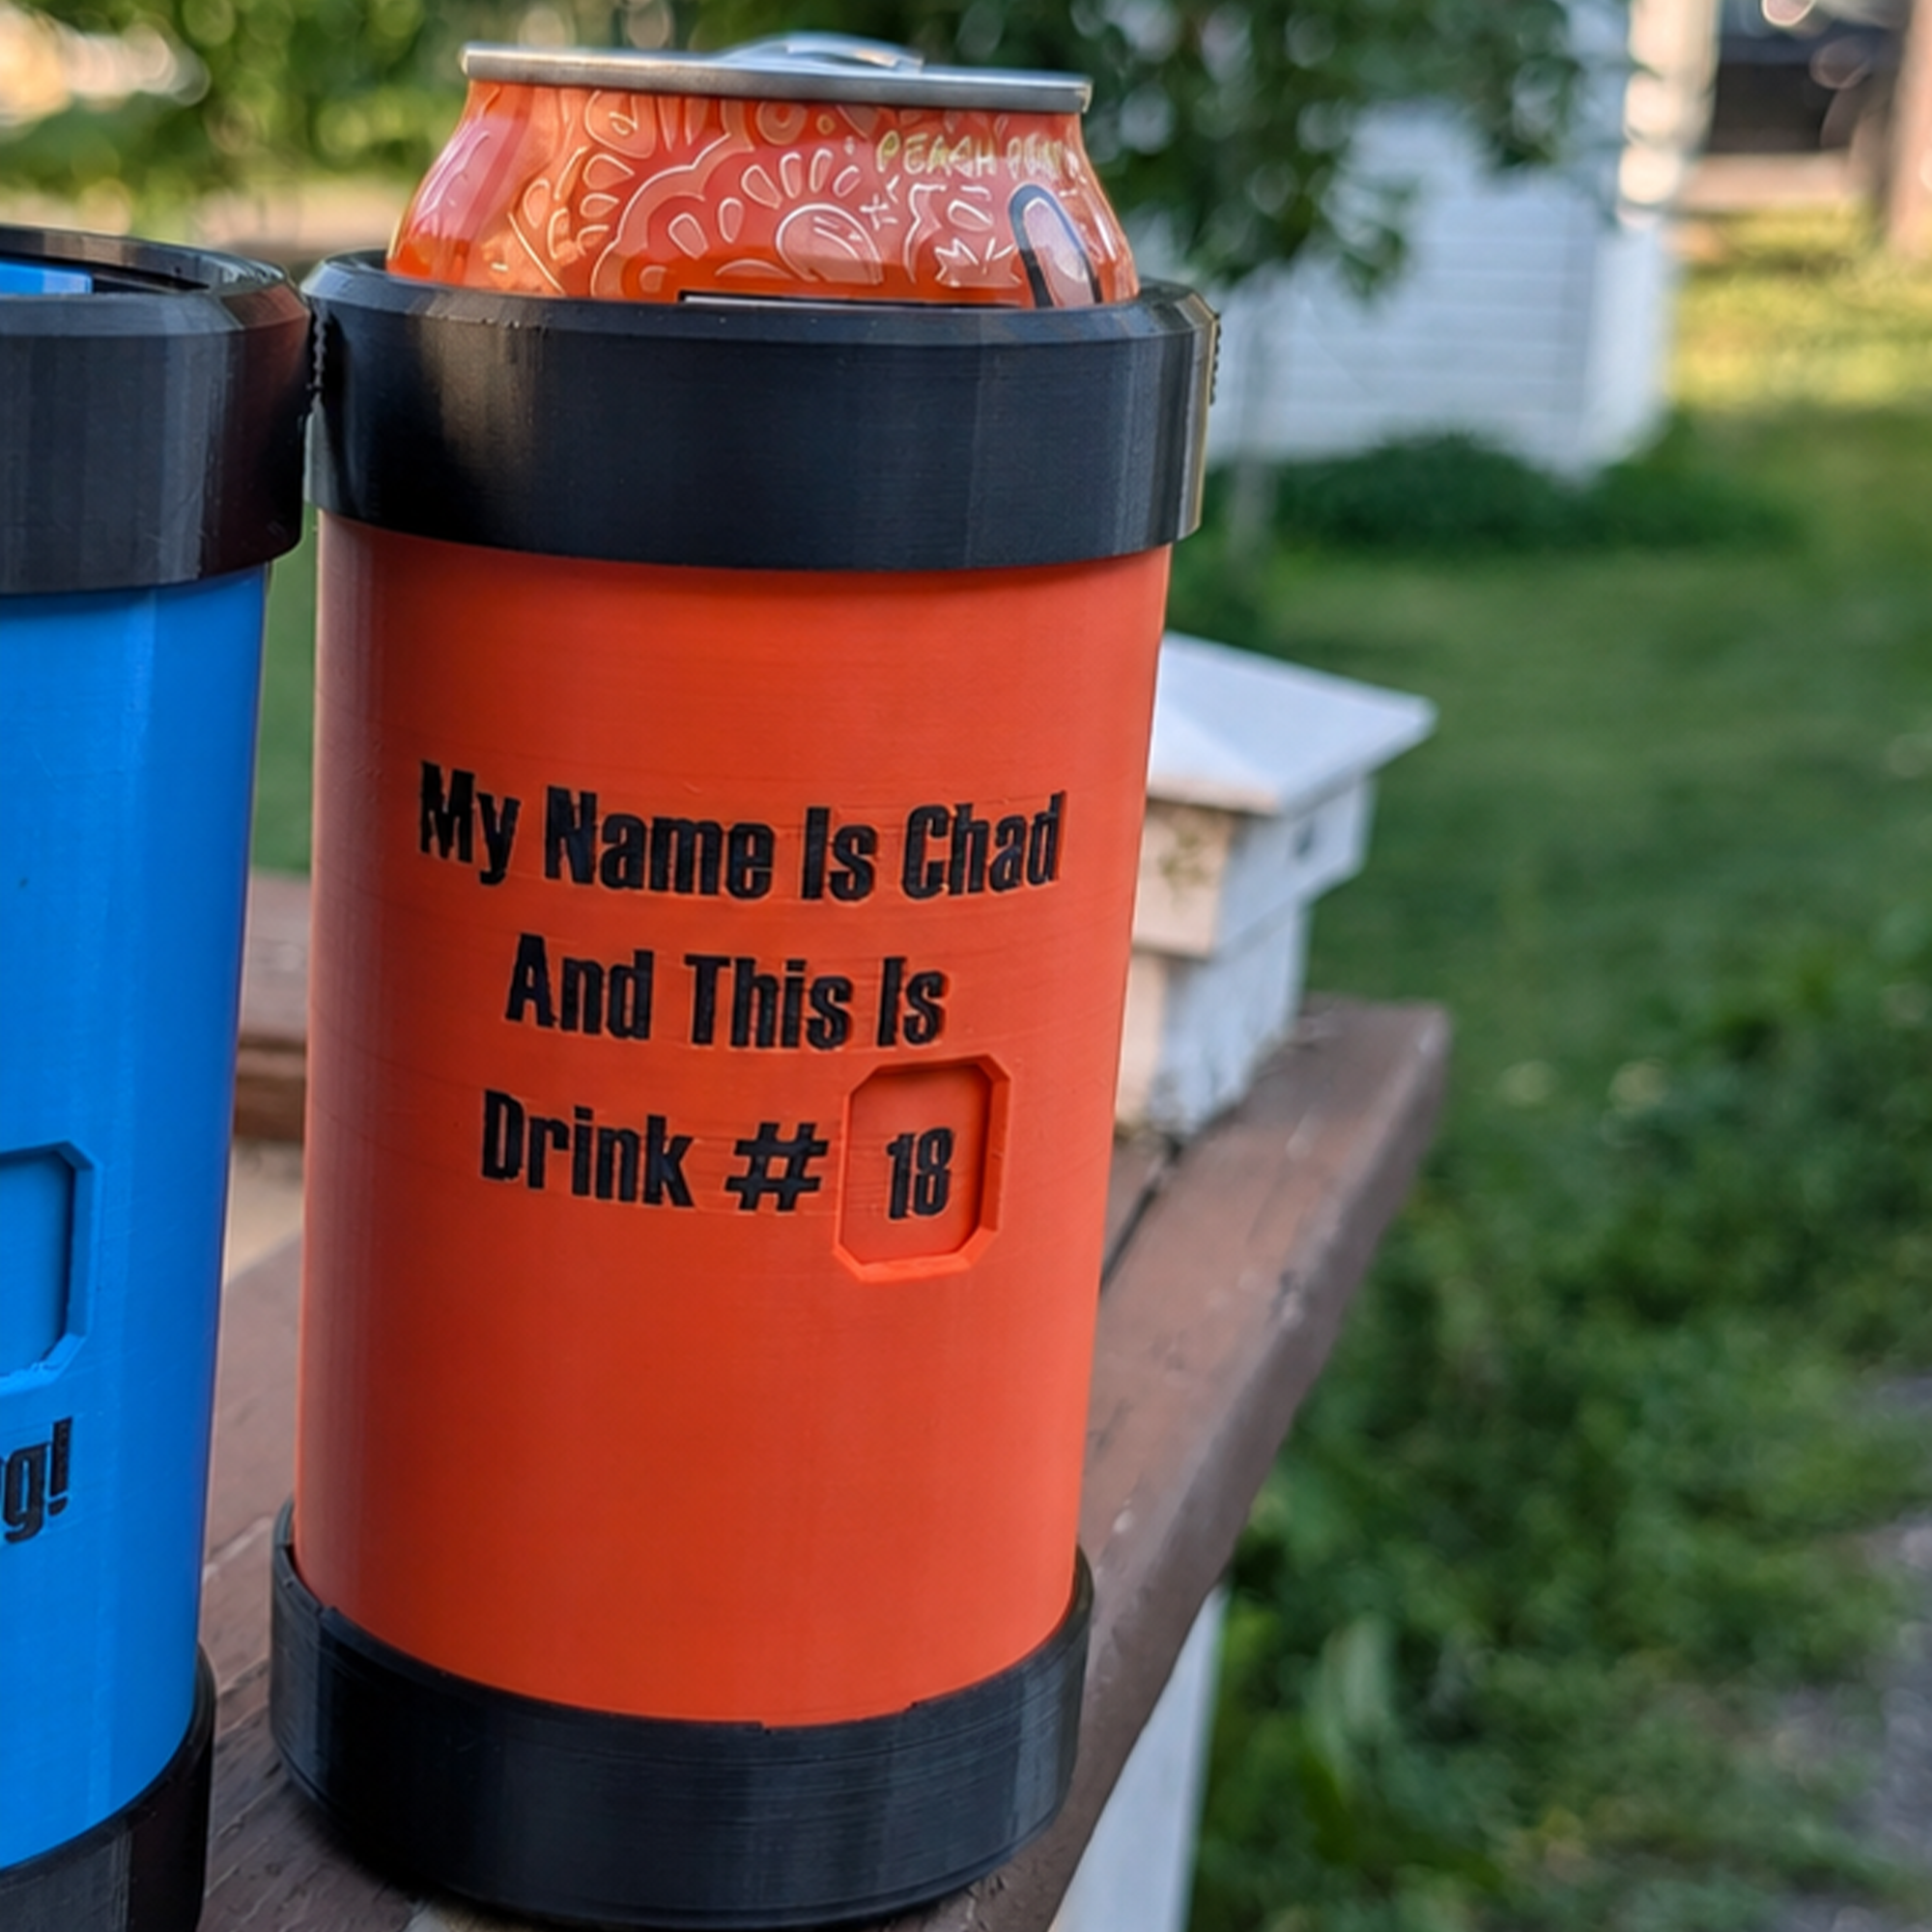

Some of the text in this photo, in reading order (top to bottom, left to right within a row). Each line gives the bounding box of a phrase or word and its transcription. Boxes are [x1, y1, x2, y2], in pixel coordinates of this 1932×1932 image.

[419, 760, 1067, 901] My Name Is Chad
[504, 932, 950, 1051] And This Is
[480, 1088, 954, 1220] Drink # 18
[0, 1414, 73, 1545] g!
